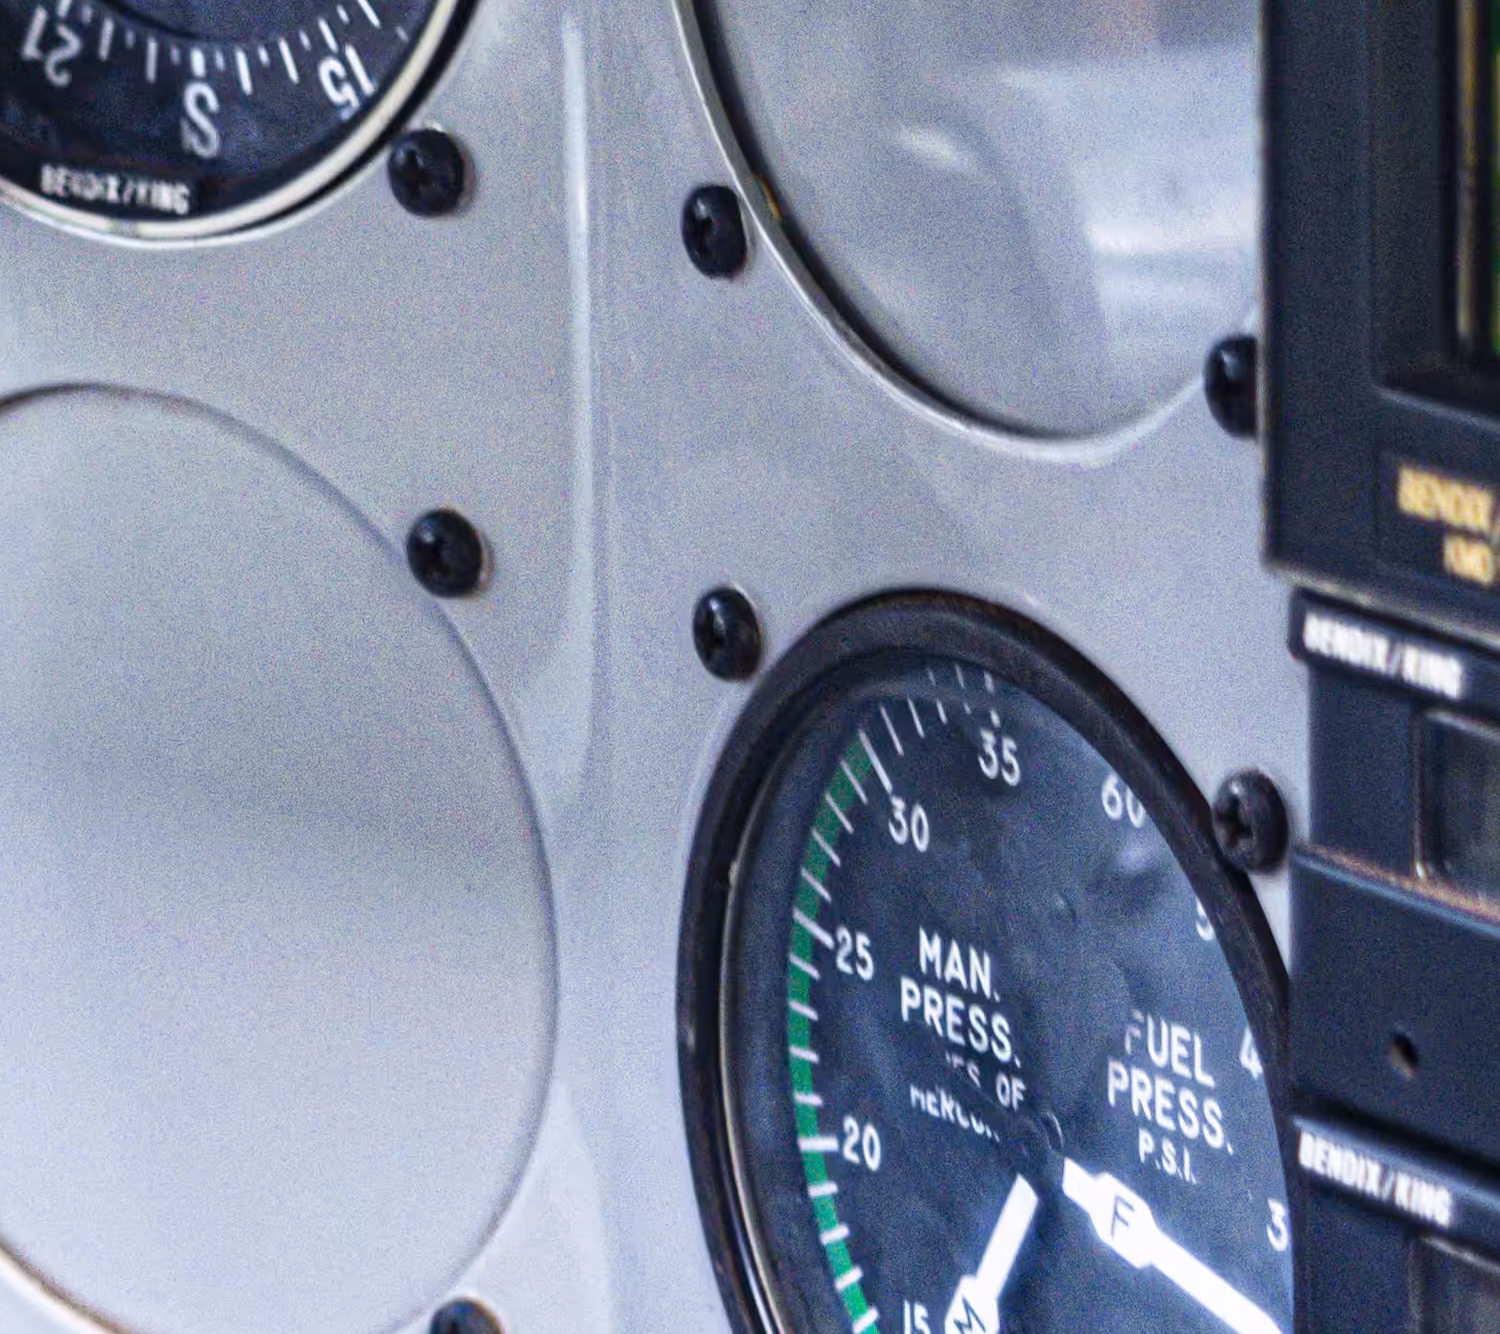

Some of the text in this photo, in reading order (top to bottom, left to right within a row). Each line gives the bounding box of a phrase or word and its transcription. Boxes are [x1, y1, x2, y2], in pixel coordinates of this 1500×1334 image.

[180, 77, 222, 157] S
[1302, 611, 1465, 701] BENDIX/KING
[978, 728, 1022, 787] 35
[888, 796, 930, 853] 30
[1102, 772, 1148, 828] 60
[834, 927, 875, 982] 25
[917, 926, 1000, 1001] MAN.
[900, 976, 1022, 1069] PRESS.
[1125, 1010, 1215, 1088] FUEL
[995, 1073, 1026, 1110] OF
[1106, 1059, 1235, 1156] PRESS.
[842, 1119, 881, 1172] 20
[1297, 1131, 1455, 1228] BENDIX/KING
[1110, 1195, 1136, 1240] F
